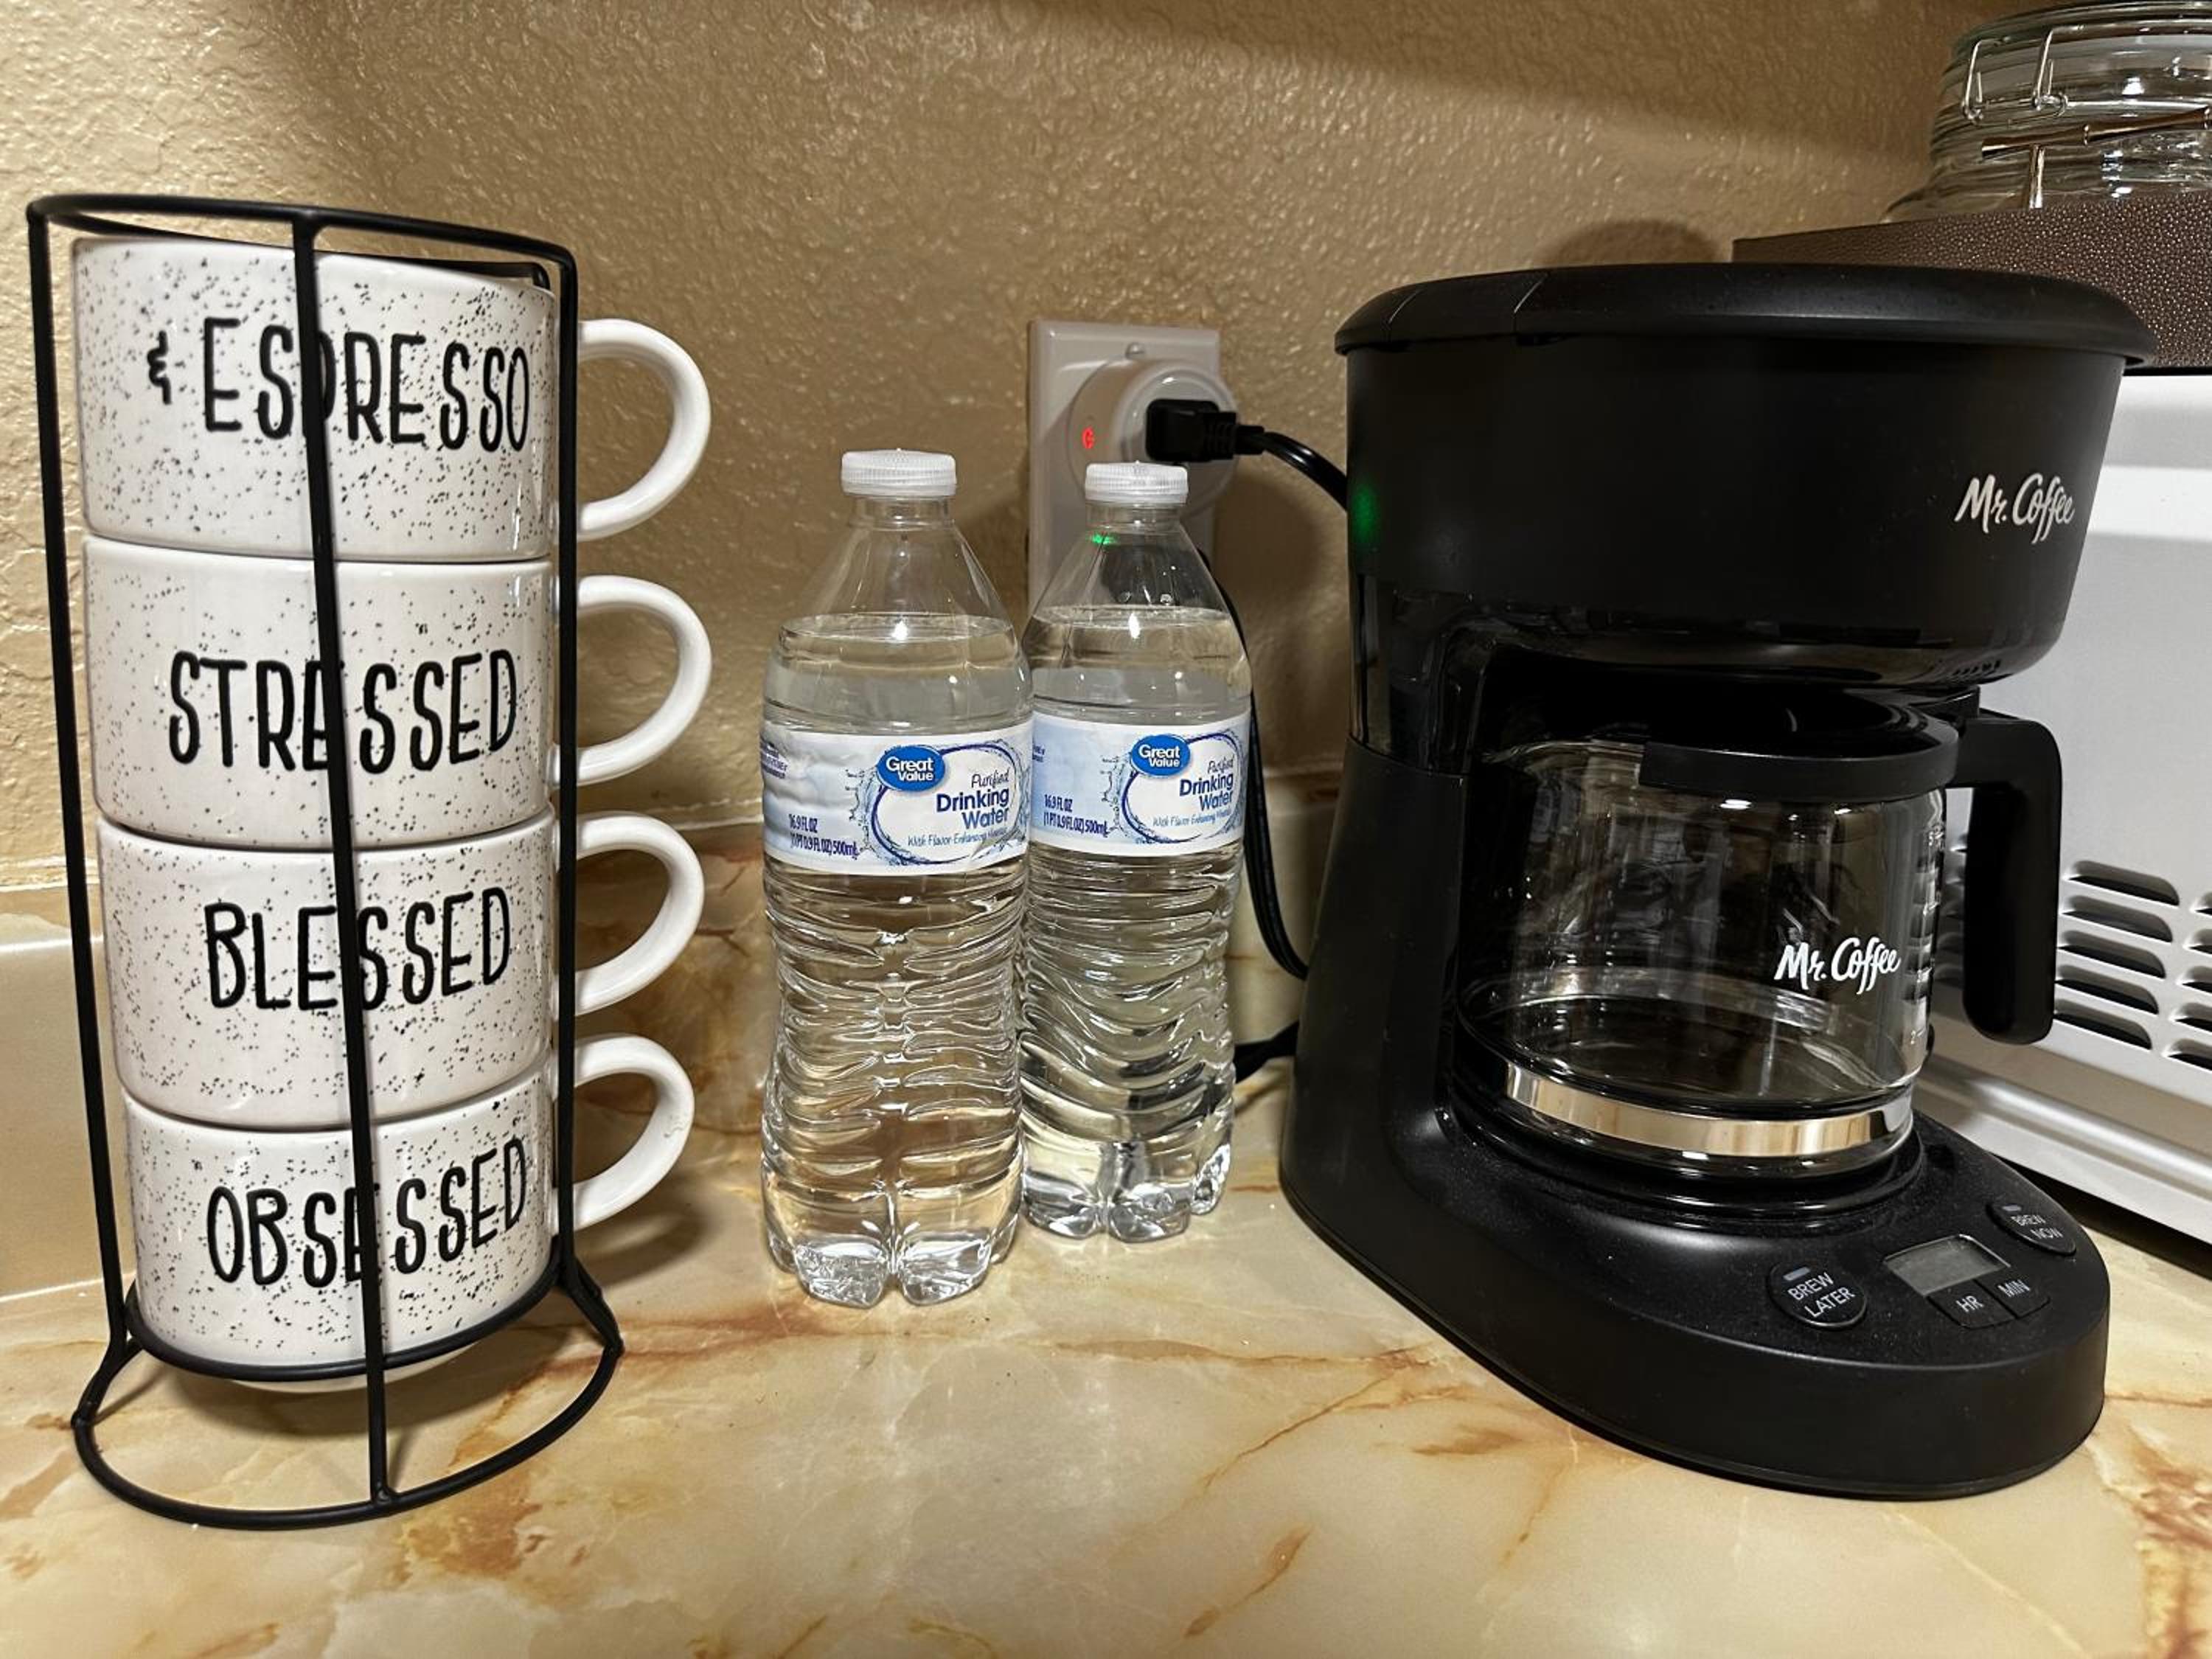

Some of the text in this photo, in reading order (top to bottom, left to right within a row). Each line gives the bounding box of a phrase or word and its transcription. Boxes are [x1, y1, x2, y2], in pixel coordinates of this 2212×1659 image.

[1954, 472, 2075, 544] Mr. Coffee
[169, 649, 517, 774] STRESSED
[1138, 744, 1180, 759] Great
[886, 756, 934, 771] Great
[1149, 758, 1180, 768] Value
[897, 771, 934, 782] Value
[970, 767, 1010, 789] Purified
[1180, 773, 1234, 797] Drinking
[936, 788, 1009, 813] Drinking
[1199, 790, 1234, 812] Water
[961, 807, 1009, 830] Water
[204, 886, 510, 1011] BLESSED
[1773, 936, 1901, 995] Mr. Coffee
[2010, 1214, 2047, 1226] BREW
[2029, 1227, 2064, 1239] NOW
[1787, 1271, 1834, 1301] BREW
[1997, 1279, 2031, 1298] MIN
[1804, 1287, 1856, 1318] LATER
[1955, 1295, 1984, 1312] HR
